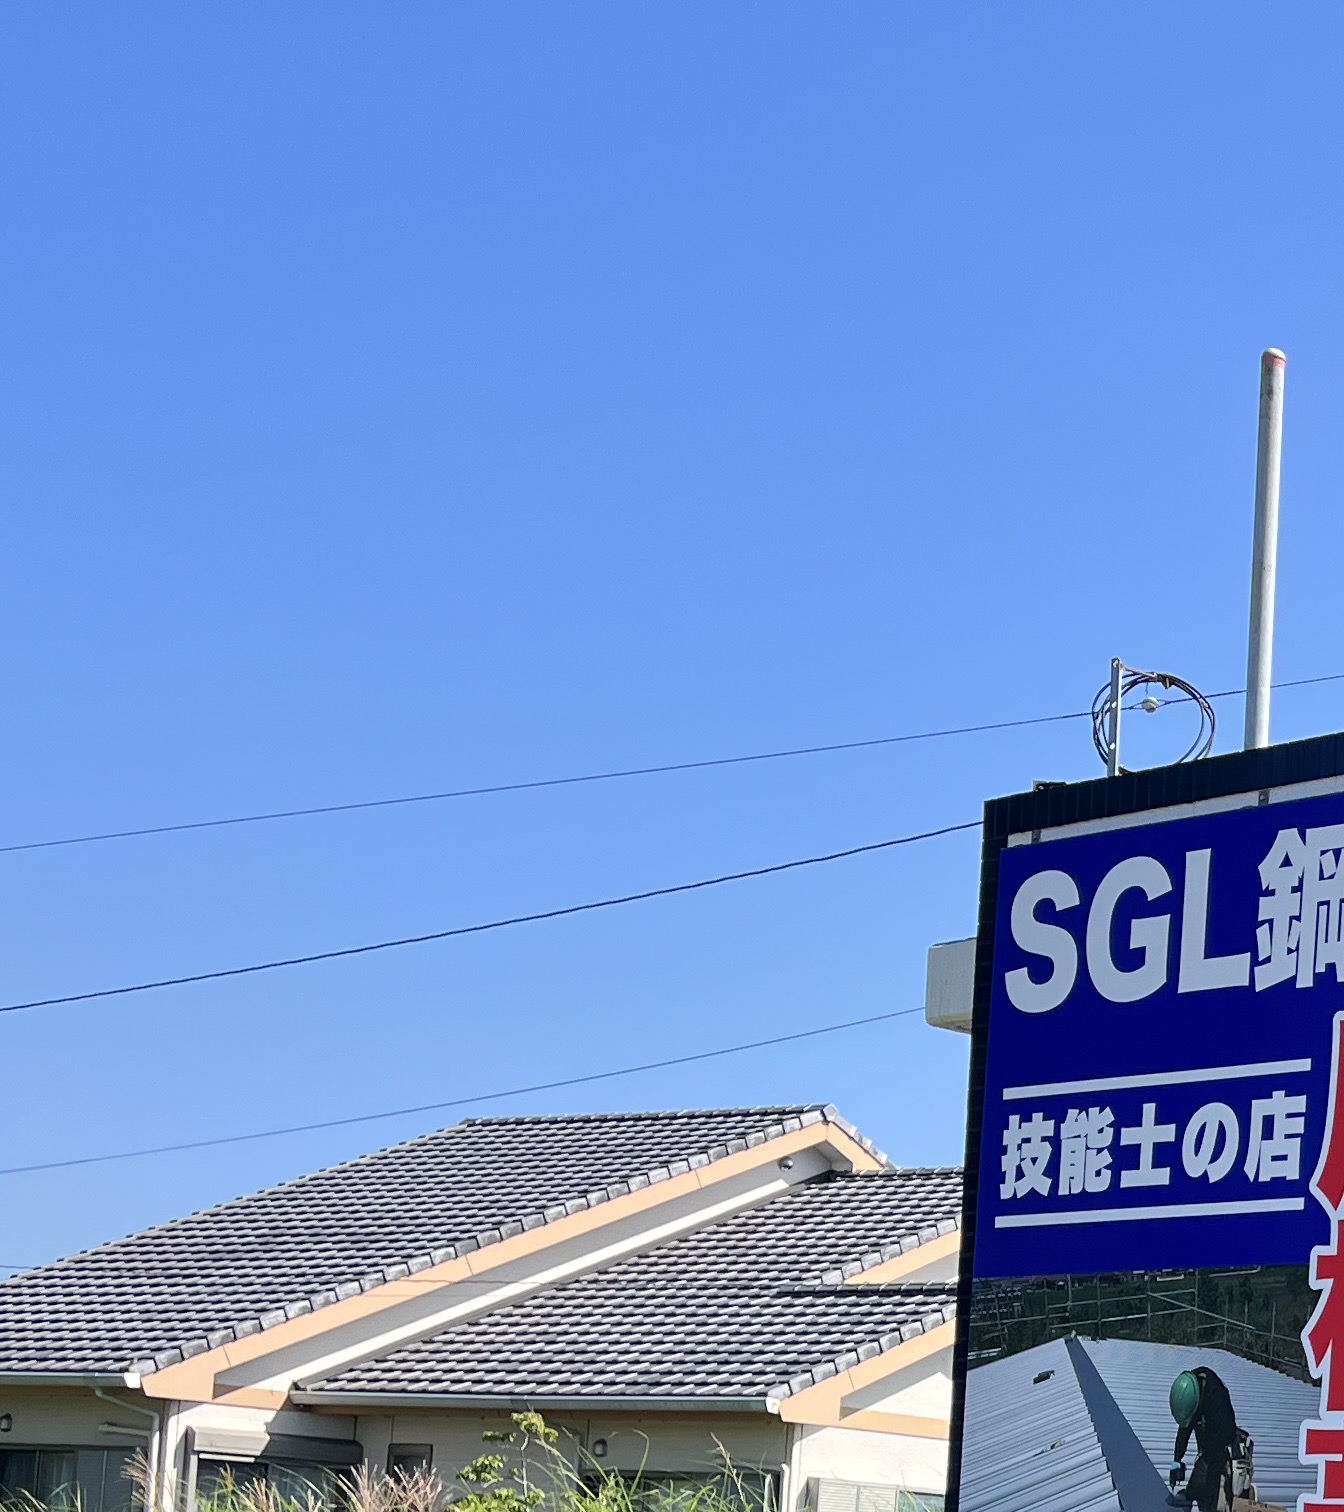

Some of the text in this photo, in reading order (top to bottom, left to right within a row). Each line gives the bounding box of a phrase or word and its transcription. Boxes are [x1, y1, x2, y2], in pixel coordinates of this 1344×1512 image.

[999, 1090, 1308, 1199] 技能士の店
